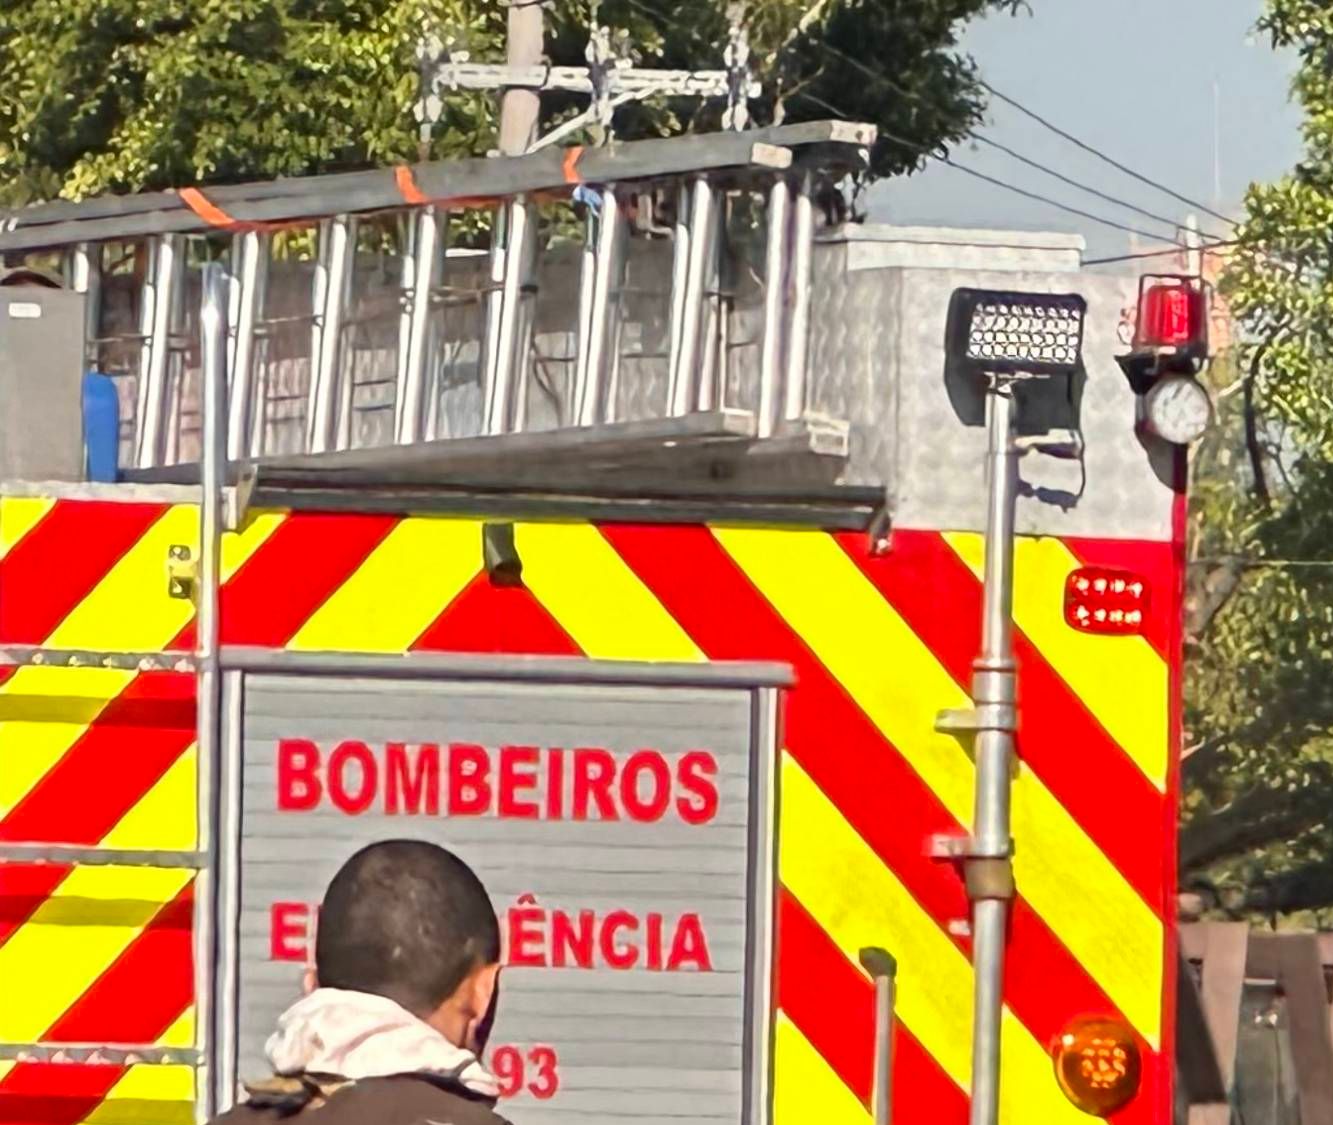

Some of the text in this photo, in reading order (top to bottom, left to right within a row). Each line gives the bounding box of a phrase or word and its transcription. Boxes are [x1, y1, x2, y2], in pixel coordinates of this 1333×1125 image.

[276, 738, 719, 825] BOMBEIROS
[269, 894, 712, 971] EÊNCIA
[491, 1045, 560, 1100] 93
